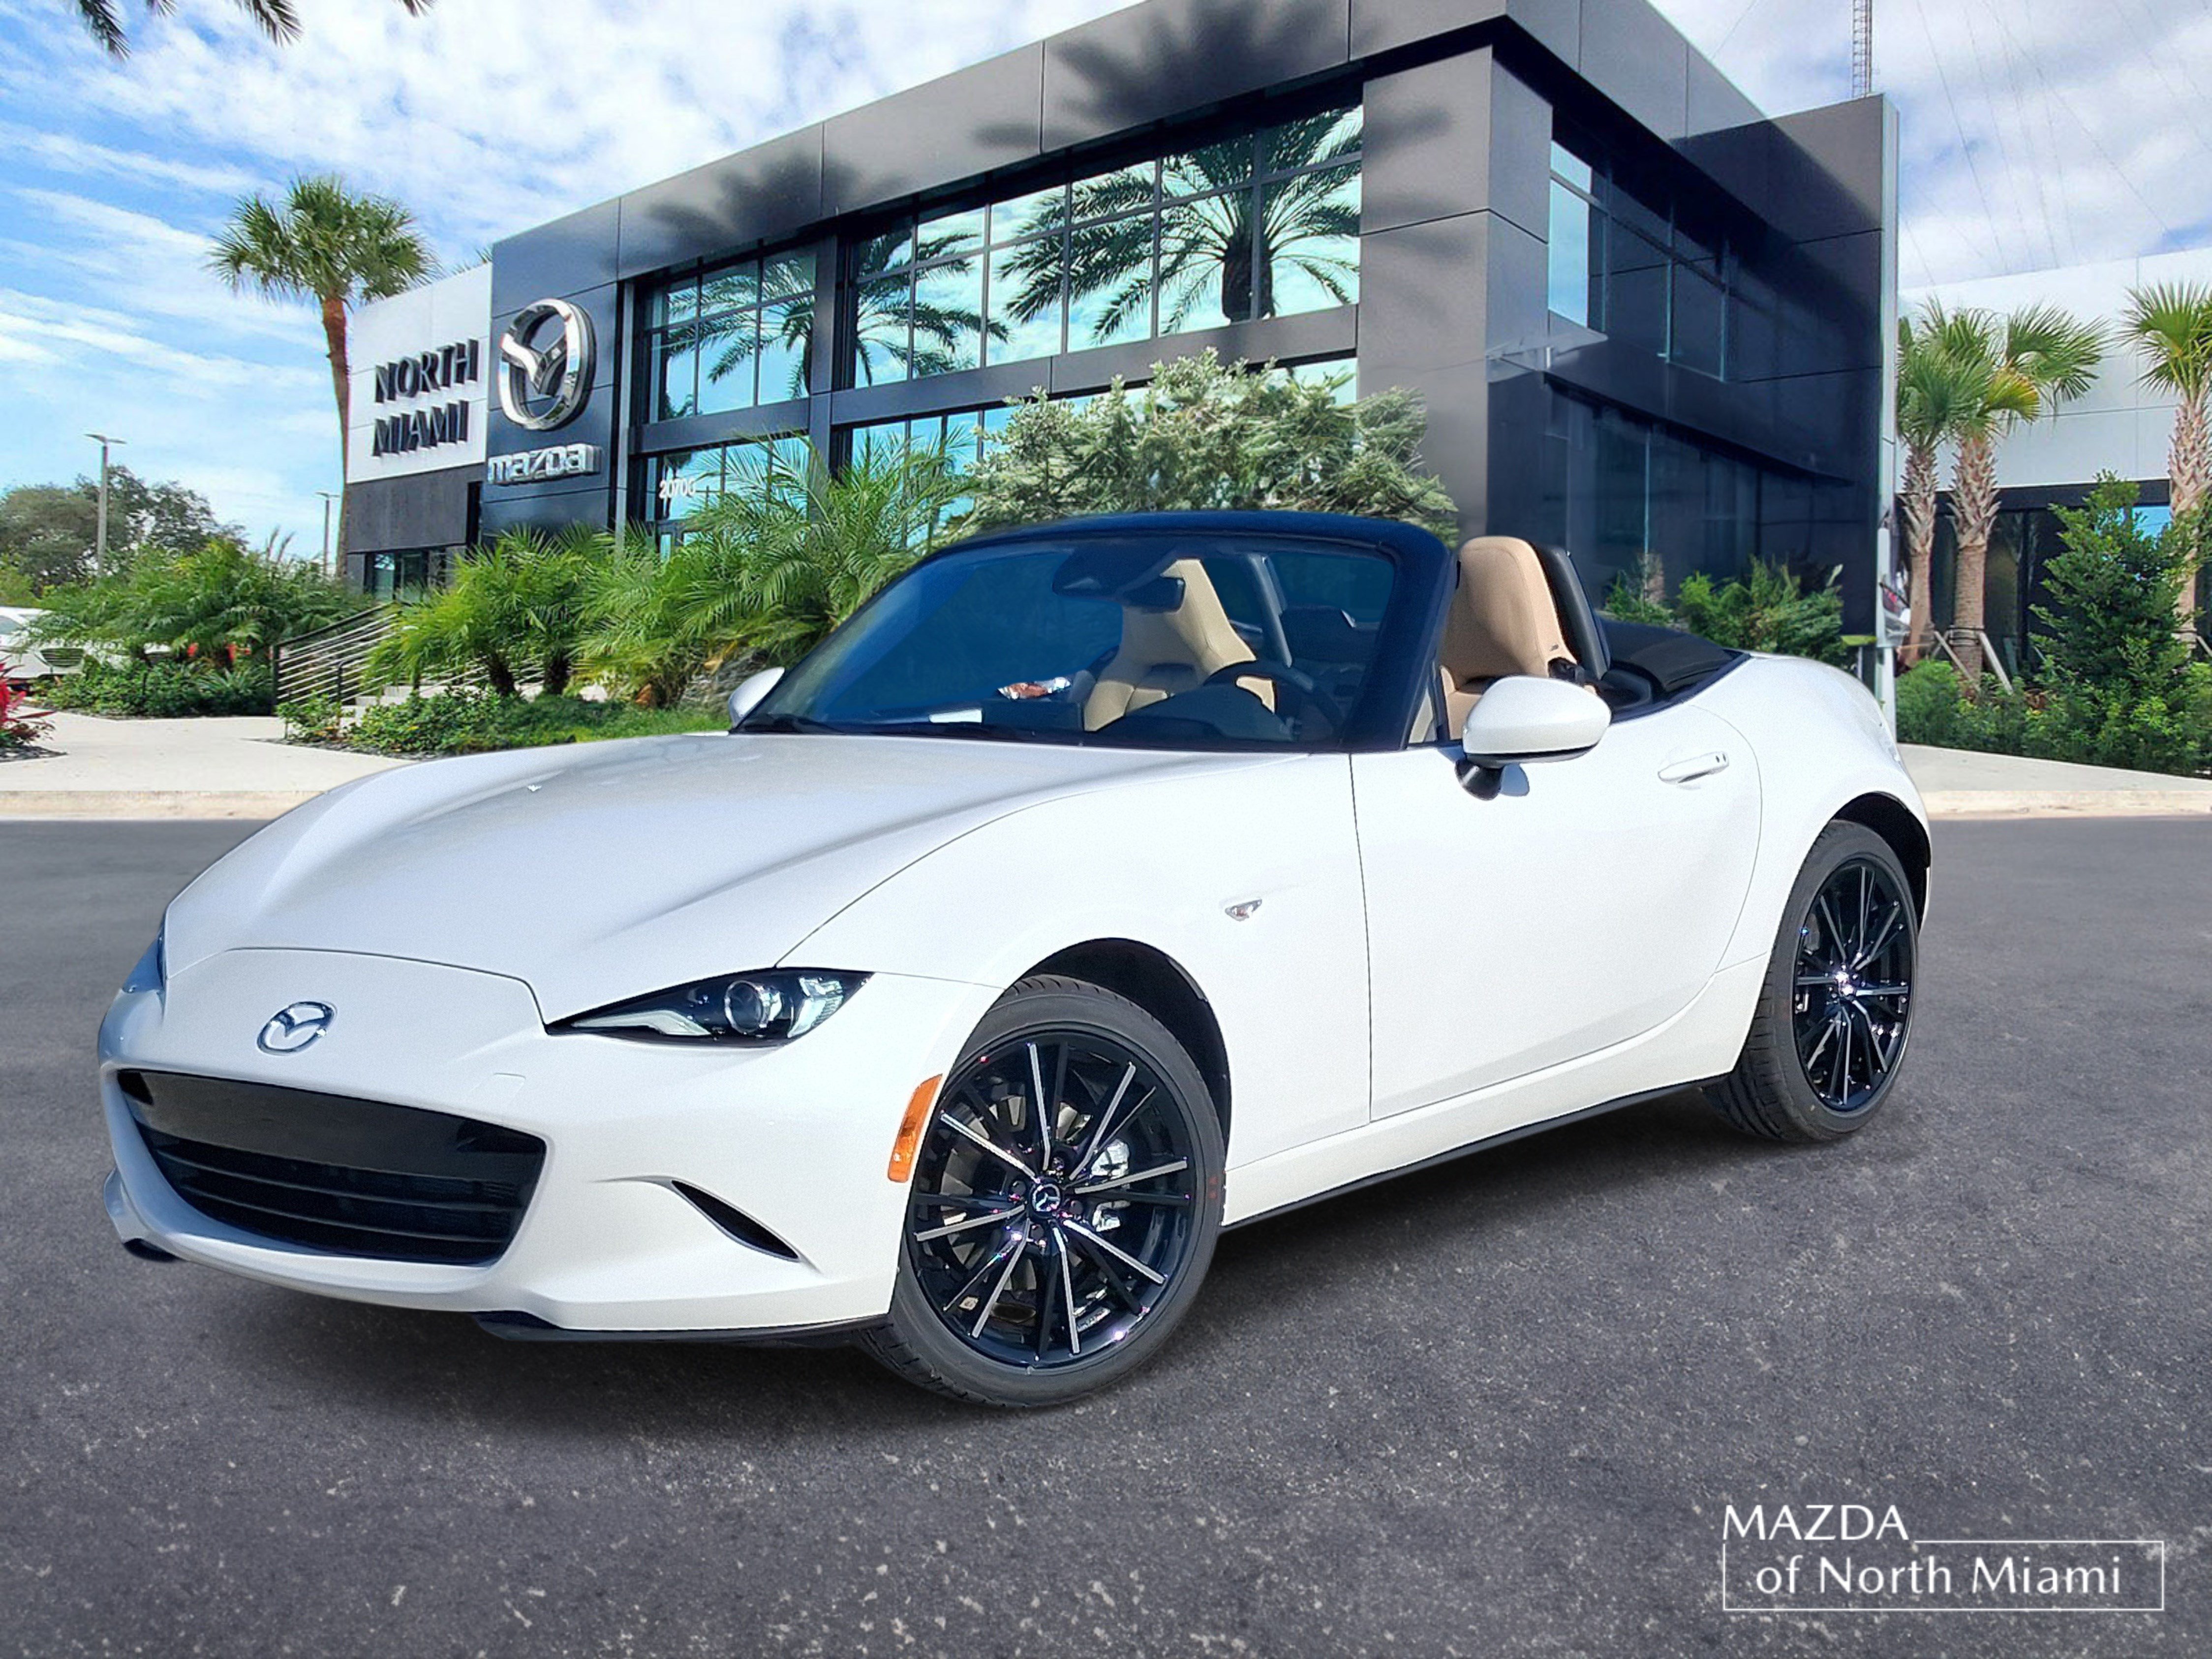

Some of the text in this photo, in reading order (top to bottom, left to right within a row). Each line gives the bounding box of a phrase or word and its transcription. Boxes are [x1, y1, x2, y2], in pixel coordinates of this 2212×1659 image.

[375, 338, 479, 403] NORTH
[372, 400, 469, 457] MIAMI
[488, 443, 599, 484] mazda
